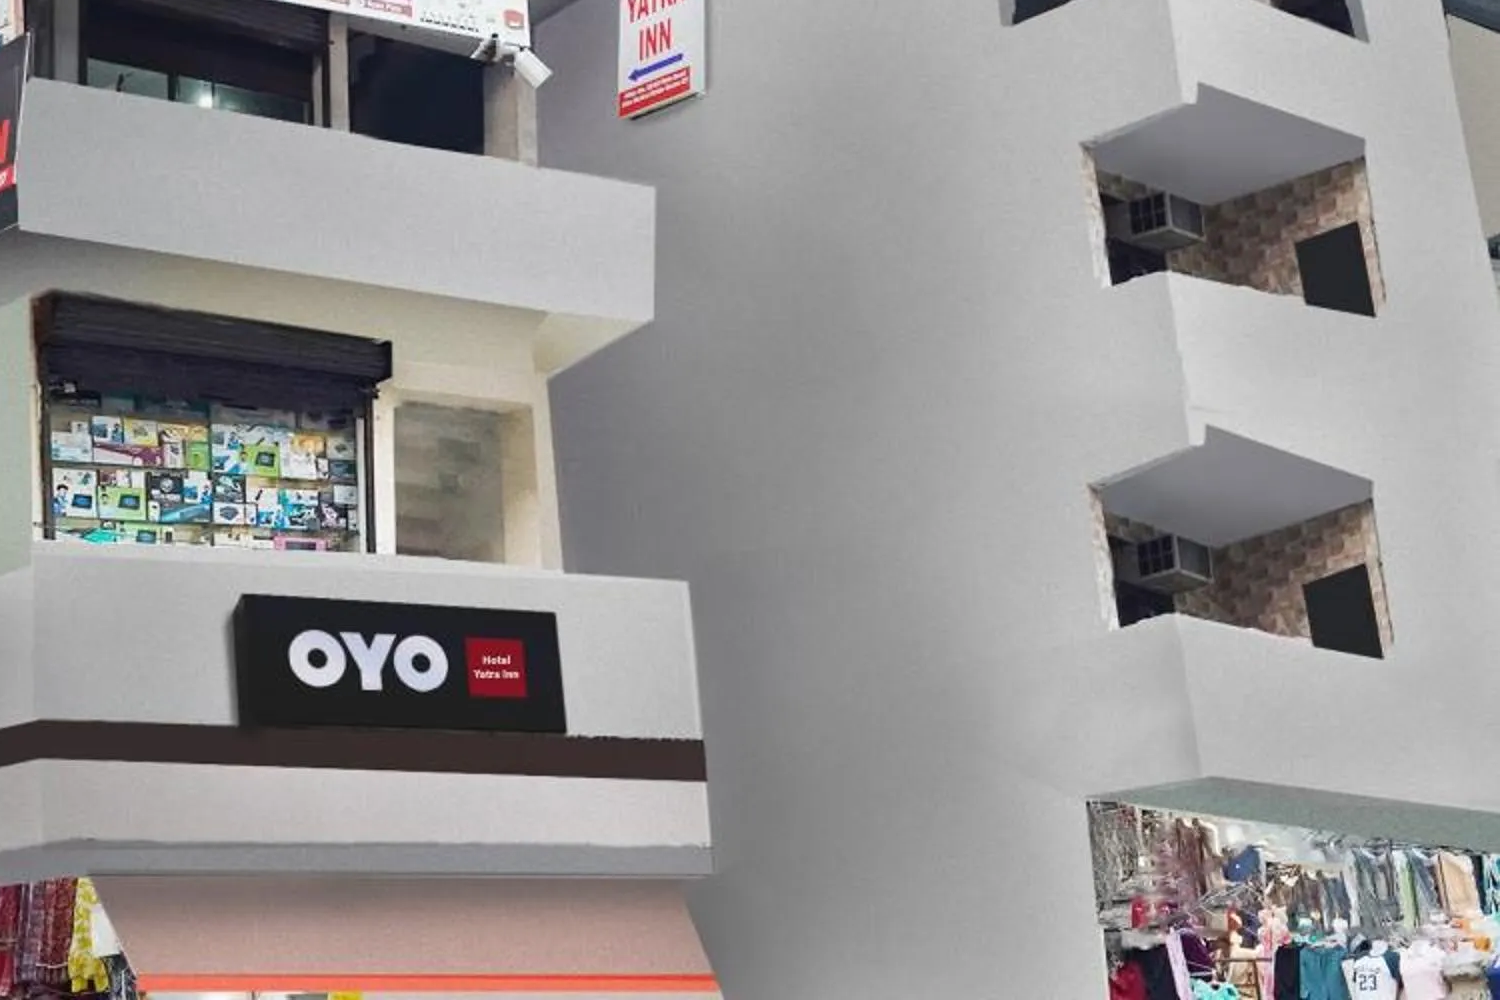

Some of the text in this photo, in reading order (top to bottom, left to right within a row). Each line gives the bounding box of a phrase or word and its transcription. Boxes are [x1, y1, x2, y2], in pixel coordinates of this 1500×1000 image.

[639, 18, 672, 61] INN
[288, 629, 449, 693] OYO
[482, 655, 511, 666] Hotel
[473, 669, 520, 680] Yatra Inn
[1358, 973, 1377, 991] 23
